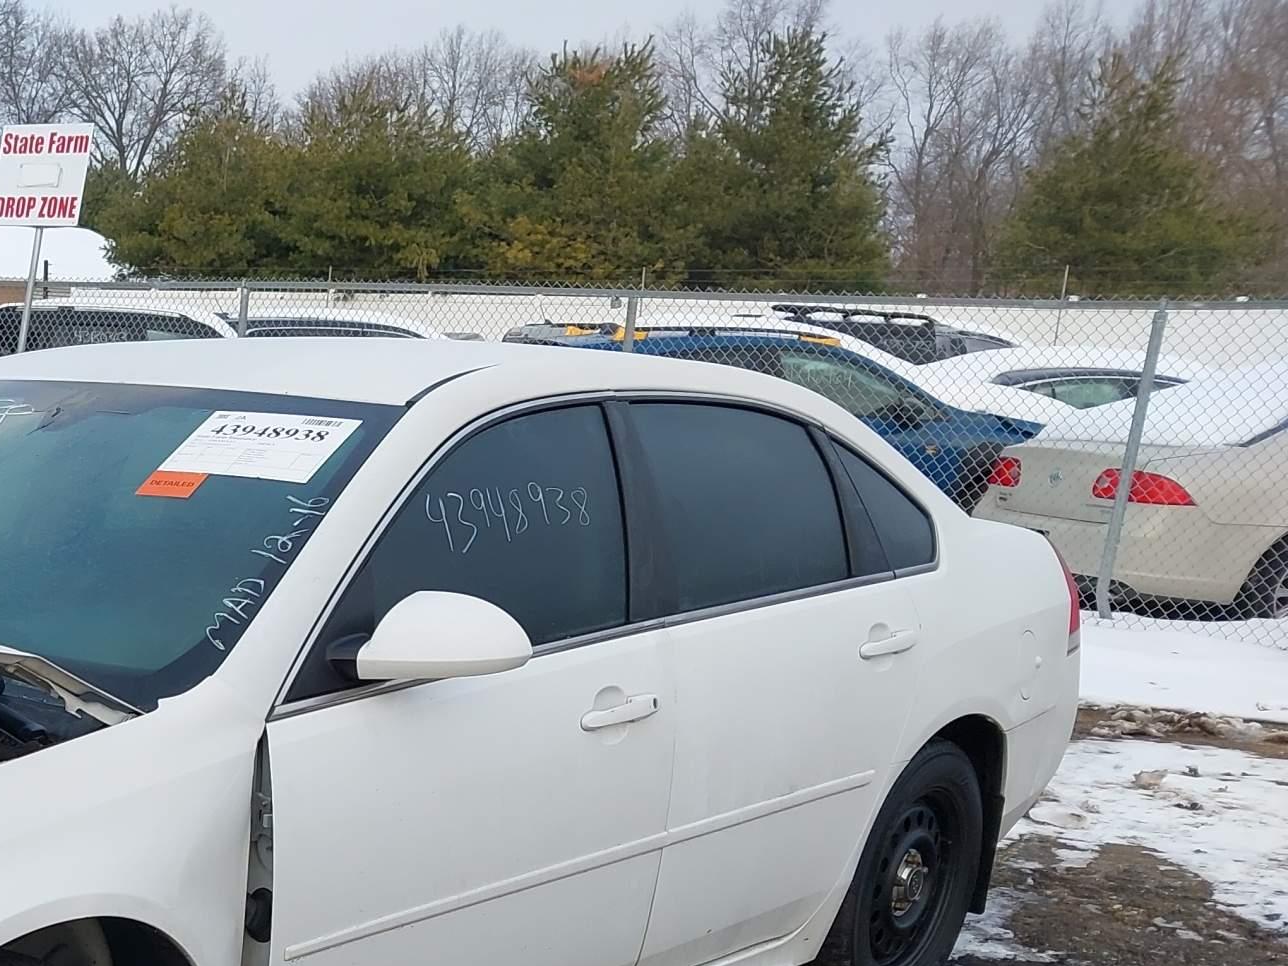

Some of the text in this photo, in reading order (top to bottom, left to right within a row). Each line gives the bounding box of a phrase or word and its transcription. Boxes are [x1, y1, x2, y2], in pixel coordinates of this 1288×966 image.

[3, 132, 89, 154] State Farm
[38, 196, 78, 218] ZONE
[210, 423, 330, 443] 43948938
[149, 479, 196, 488] DETAILED
[425, 482, 590, 553] 43948938
[205, 578, 265, 650] MAD
